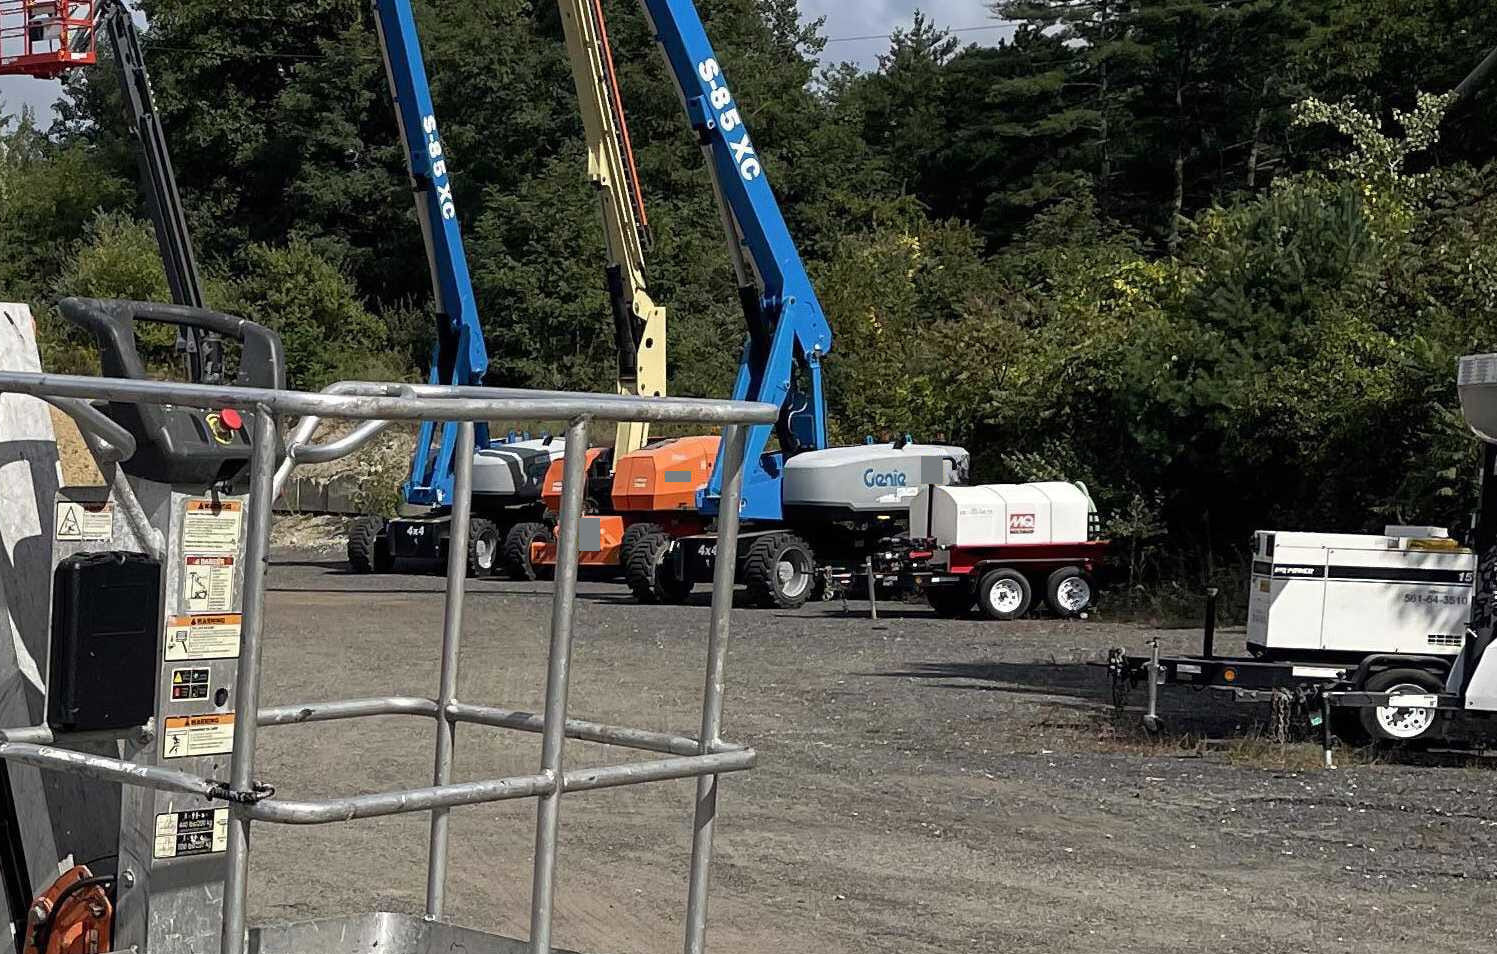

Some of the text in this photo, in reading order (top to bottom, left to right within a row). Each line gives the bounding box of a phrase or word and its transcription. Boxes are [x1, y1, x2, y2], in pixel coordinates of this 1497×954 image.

[698, 57, 761, 181] S-85 XC
[422, 114, 454, 220] S-85 XC
[863, 468, 906, 488] Genie
[1010, 514, 1035, 528] MQ
[406, 525, 425, 536] 4x4
[697, 544, 717, 556] 4x4
